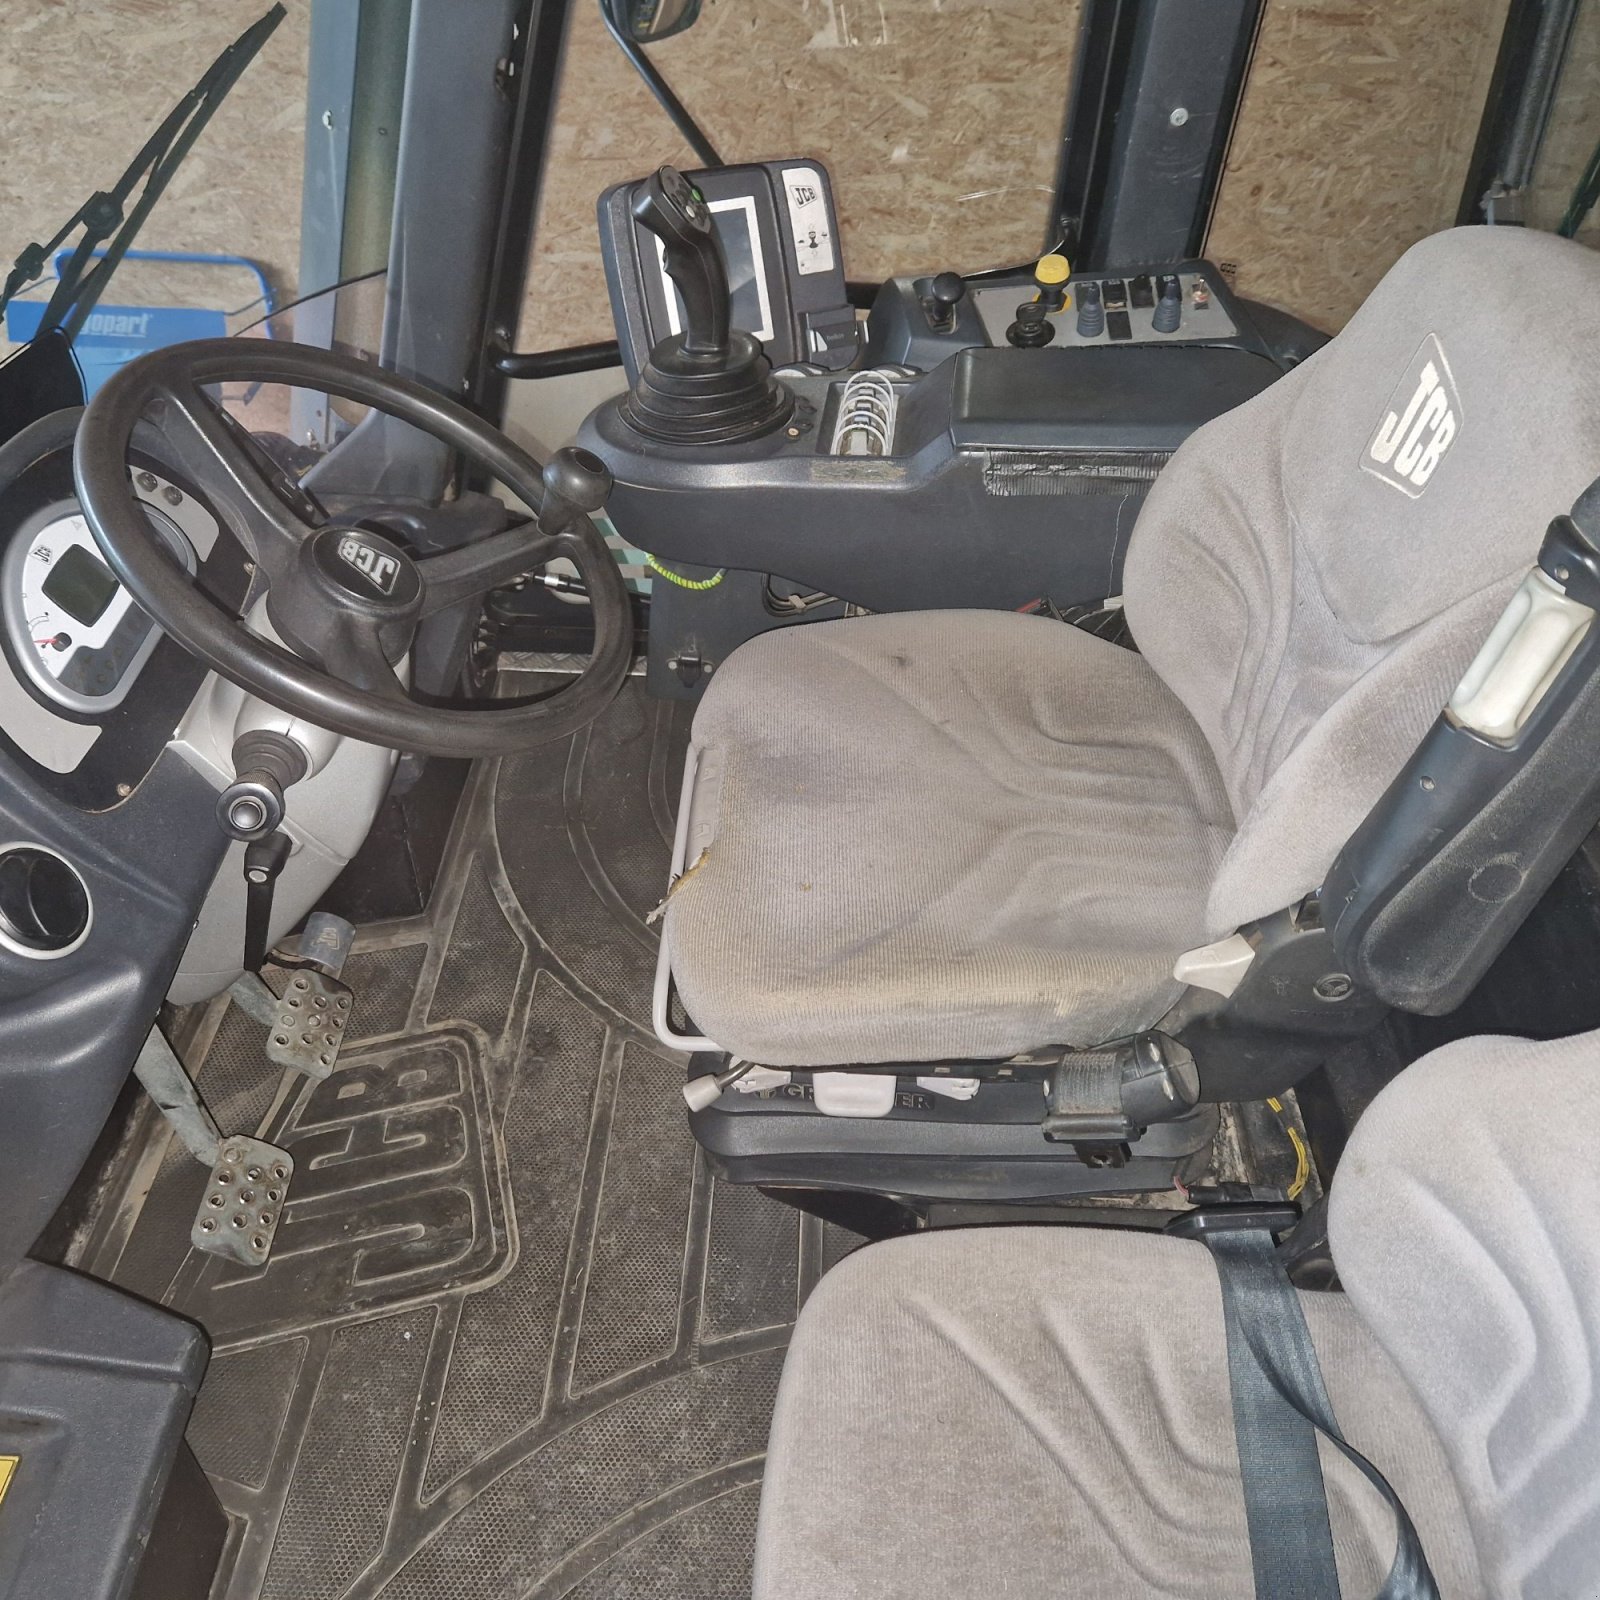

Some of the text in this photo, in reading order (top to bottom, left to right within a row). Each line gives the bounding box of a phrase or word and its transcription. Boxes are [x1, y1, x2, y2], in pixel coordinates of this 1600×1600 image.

[795, 187, 816, 205] JCB
[1371, 360, 1456, 486] JCB
[33, 546, 52, 563] JCB
[341, 540, 395, 585] JCB
[211, 1047, 476, 1292] JCB
